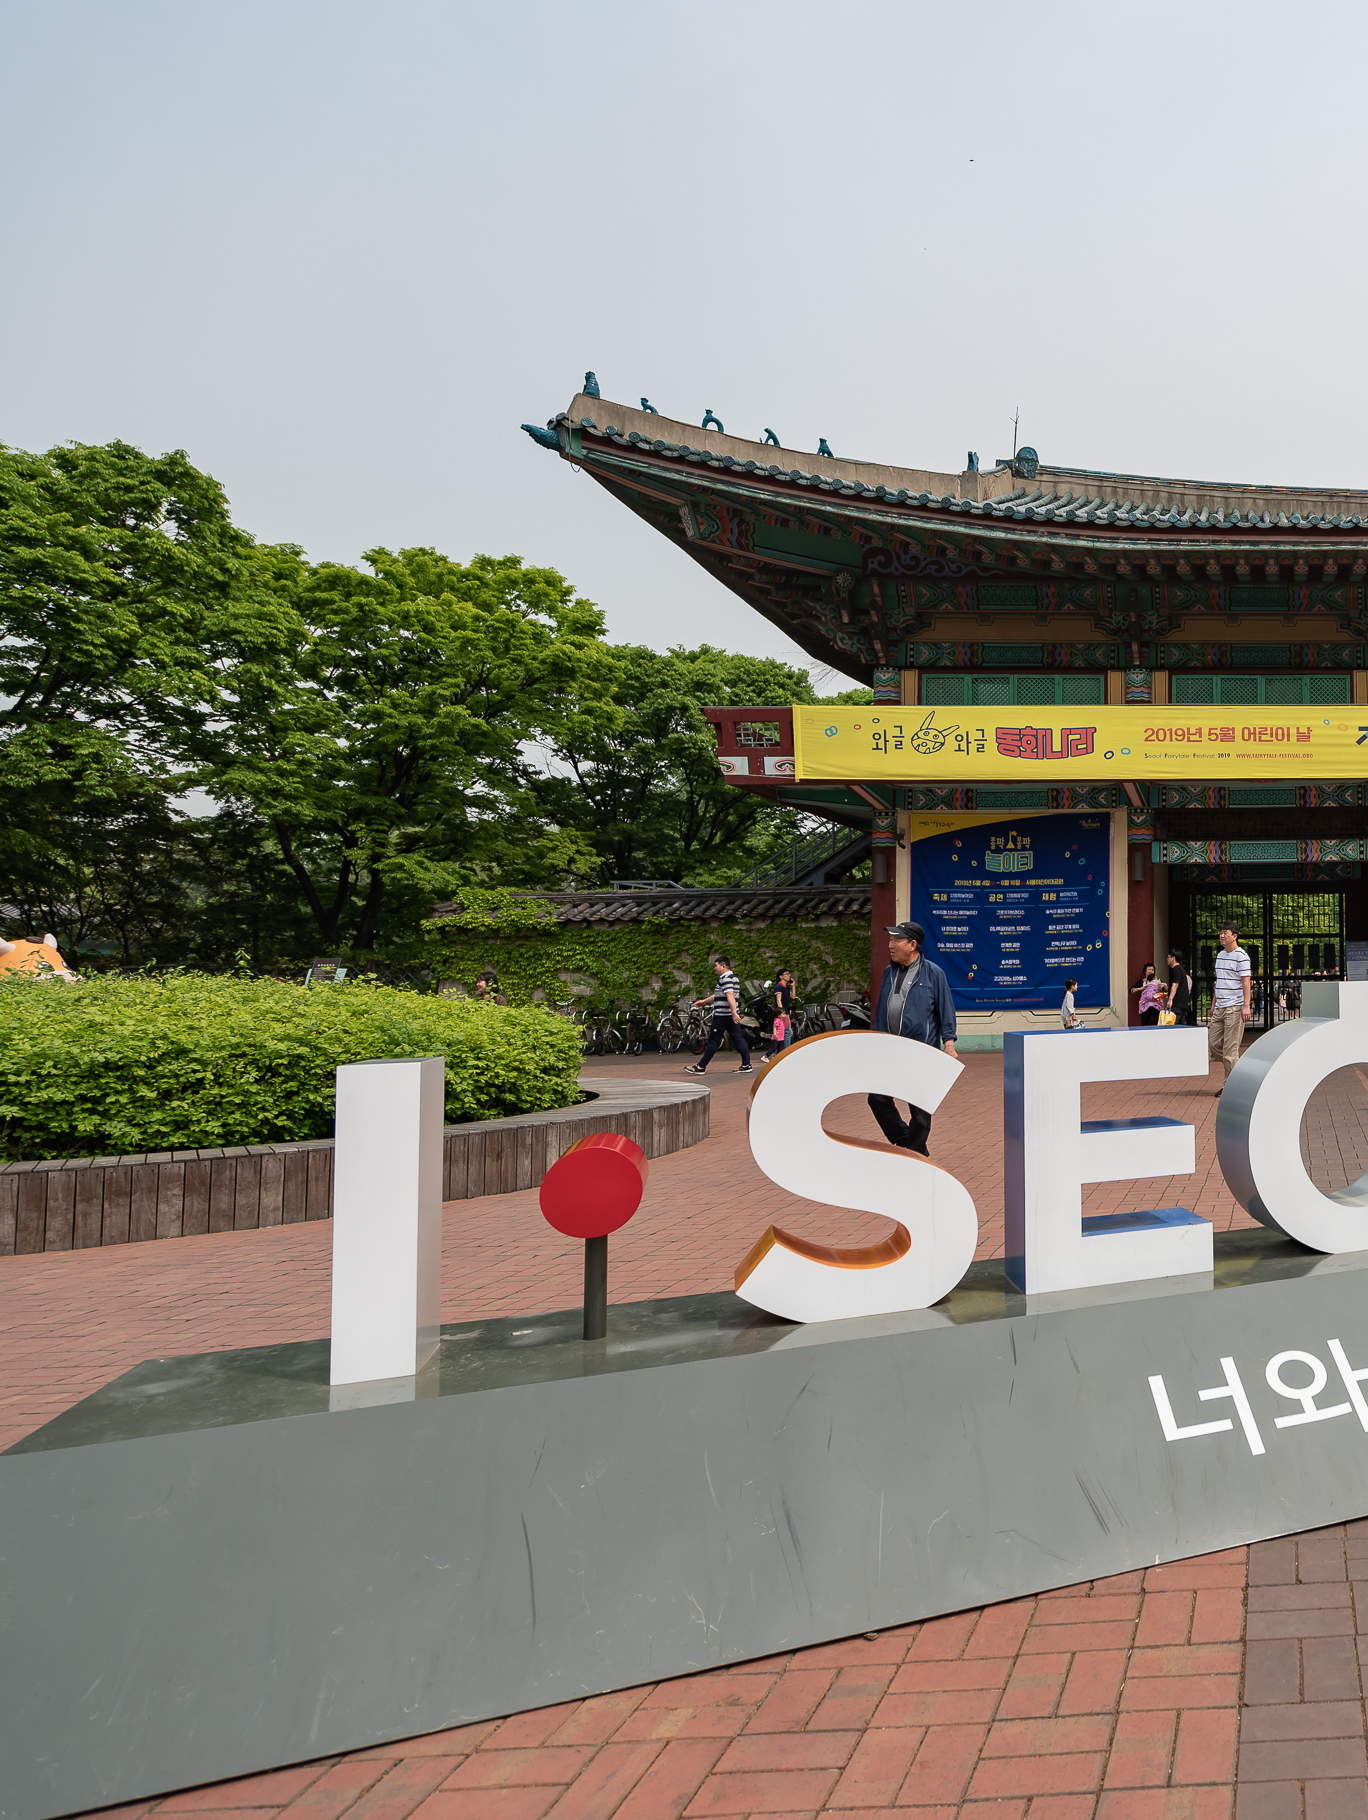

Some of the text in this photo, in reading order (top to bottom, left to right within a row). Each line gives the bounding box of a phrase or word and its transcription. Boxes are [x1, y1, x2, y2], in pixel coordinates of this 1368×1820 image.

[871, 725, 988, 756] 와글 와글
[995, 725, 1097, 760] 동화나라
[1143, 726, 1313, 743] 2019년 5월 어린이 날
[1164, 752, 1190, 760] Fairytale
[985, 850, 1034, 872] 놀이터
